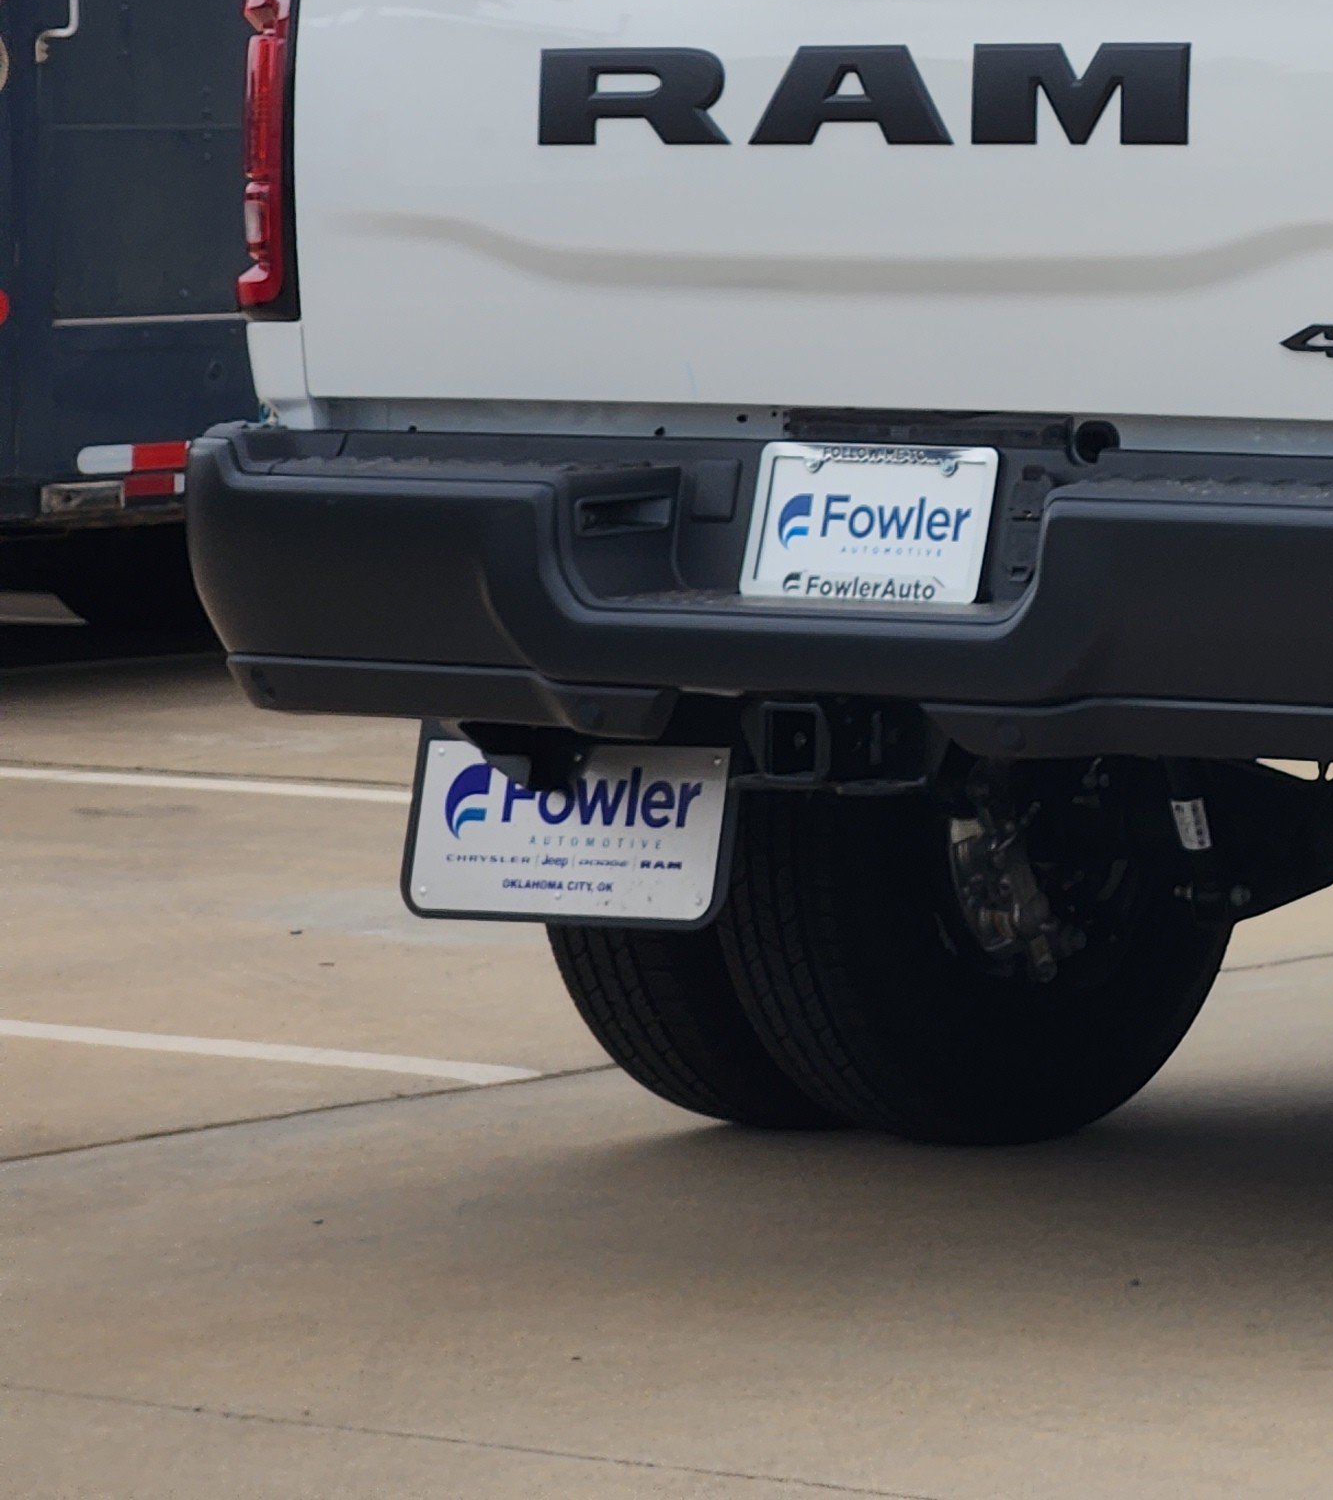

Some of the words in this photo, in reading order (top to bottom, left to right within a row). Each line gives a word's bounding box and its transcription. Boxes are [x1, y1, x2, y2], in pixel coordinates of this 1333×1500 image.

[537, 42, 1193, 147] RAM
[819, 493, 972, 542] Fowler
[840, 545, 943, 557] AUTOMOTIVE
[804, 574, 936, 600] FowlerAuto
[501, 766, 704, 829] Fowler
[529, 835, 663, 850] AUTOMOTIVE
[446, 853, 531, 864] CHRYSLER
[541, 853, 569, 869] Jeep
[640, 860, 683, 870] RAM
[502, 877, 564, 891] OKLAHOMA
[597, 881, 613, 893] OK
